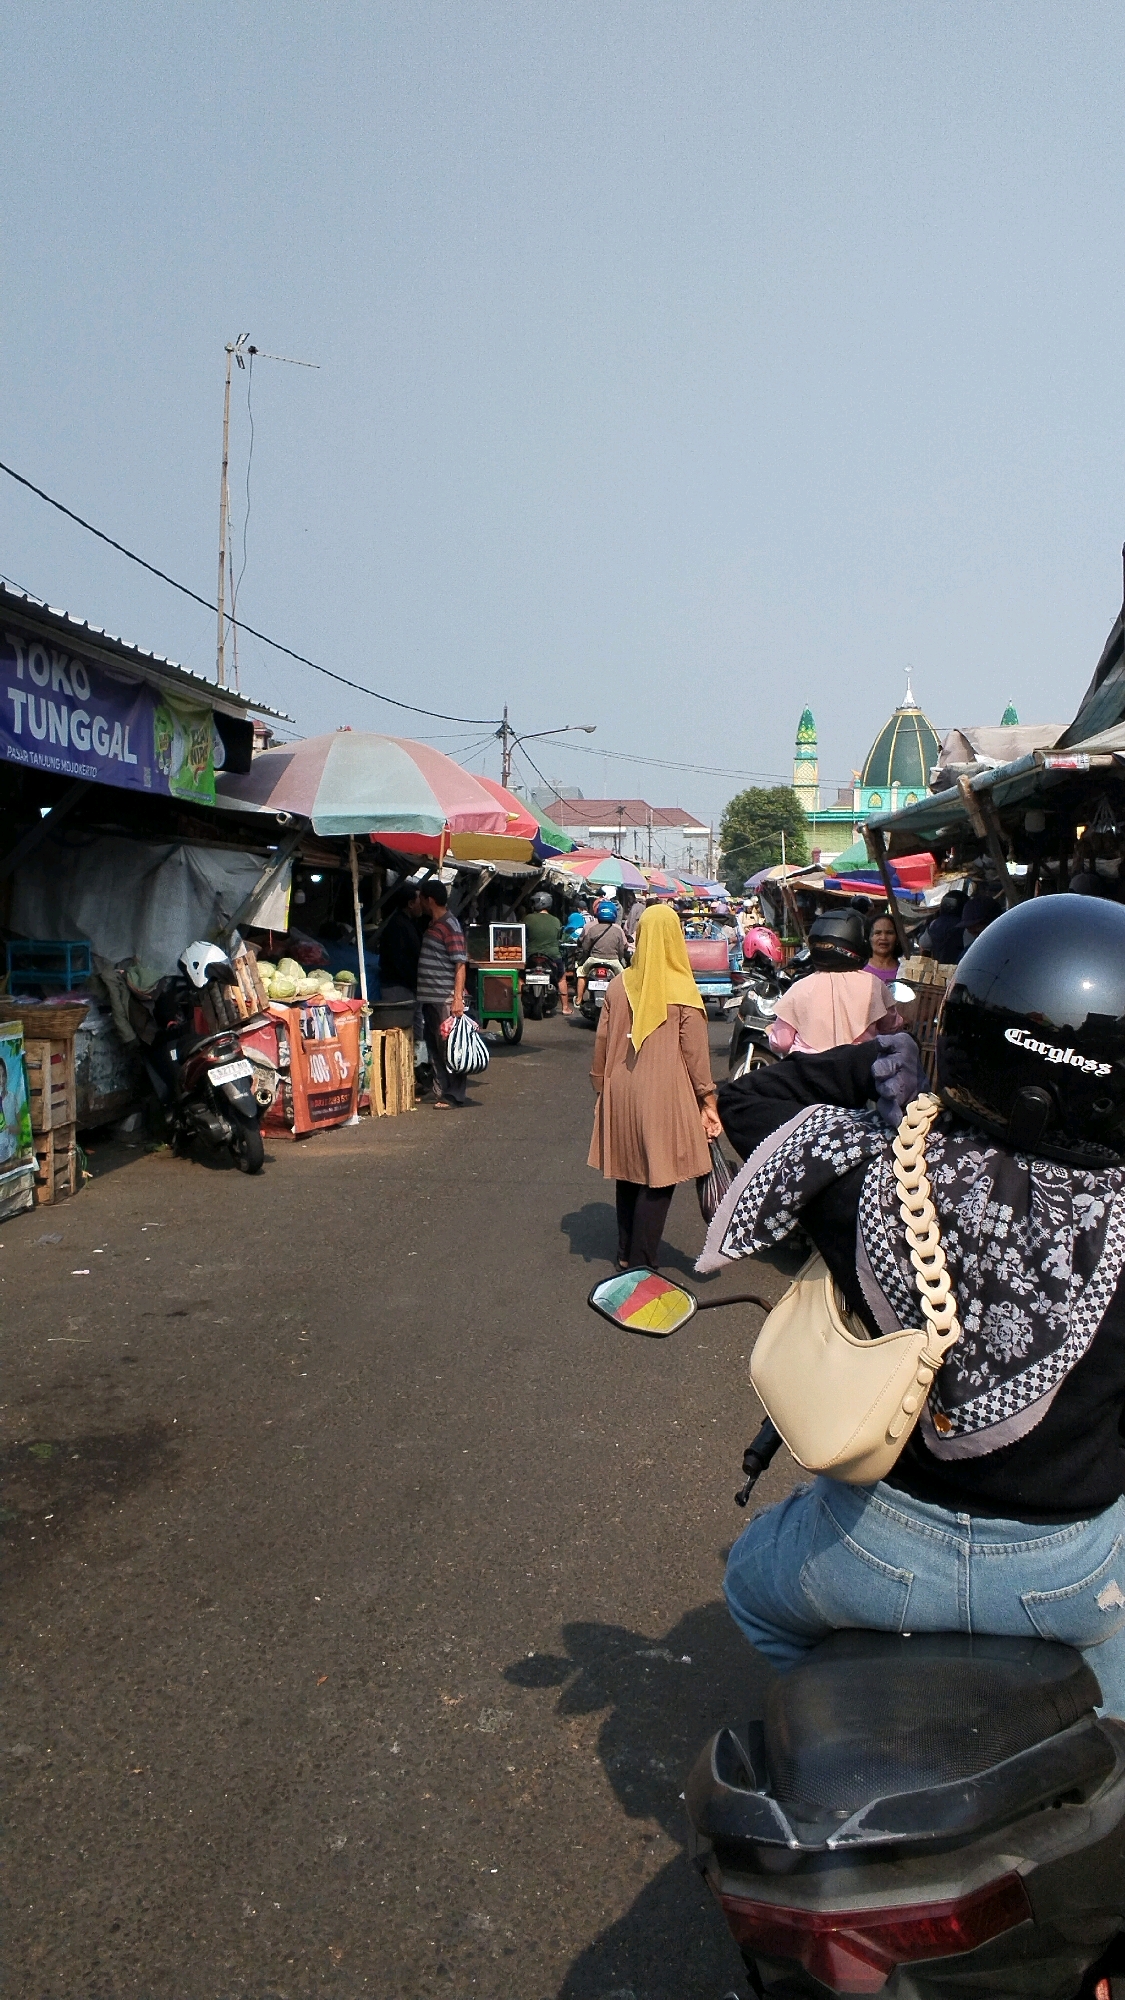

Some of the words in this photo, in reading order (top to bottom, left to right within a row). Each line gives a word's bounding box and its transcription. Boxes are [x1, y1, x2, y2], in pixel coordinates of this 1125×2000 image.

[4, 631, 91, 701] TOKO
[7, 686, 138, 765] TUNGGAL
[6, 745, 29, 763] PASAR
[29, 751, 60, 770] TANJUNG
[60, 759, 98, 778] MOJOKERTO
[1004, 1028, 1113, 1078] Cargloss
